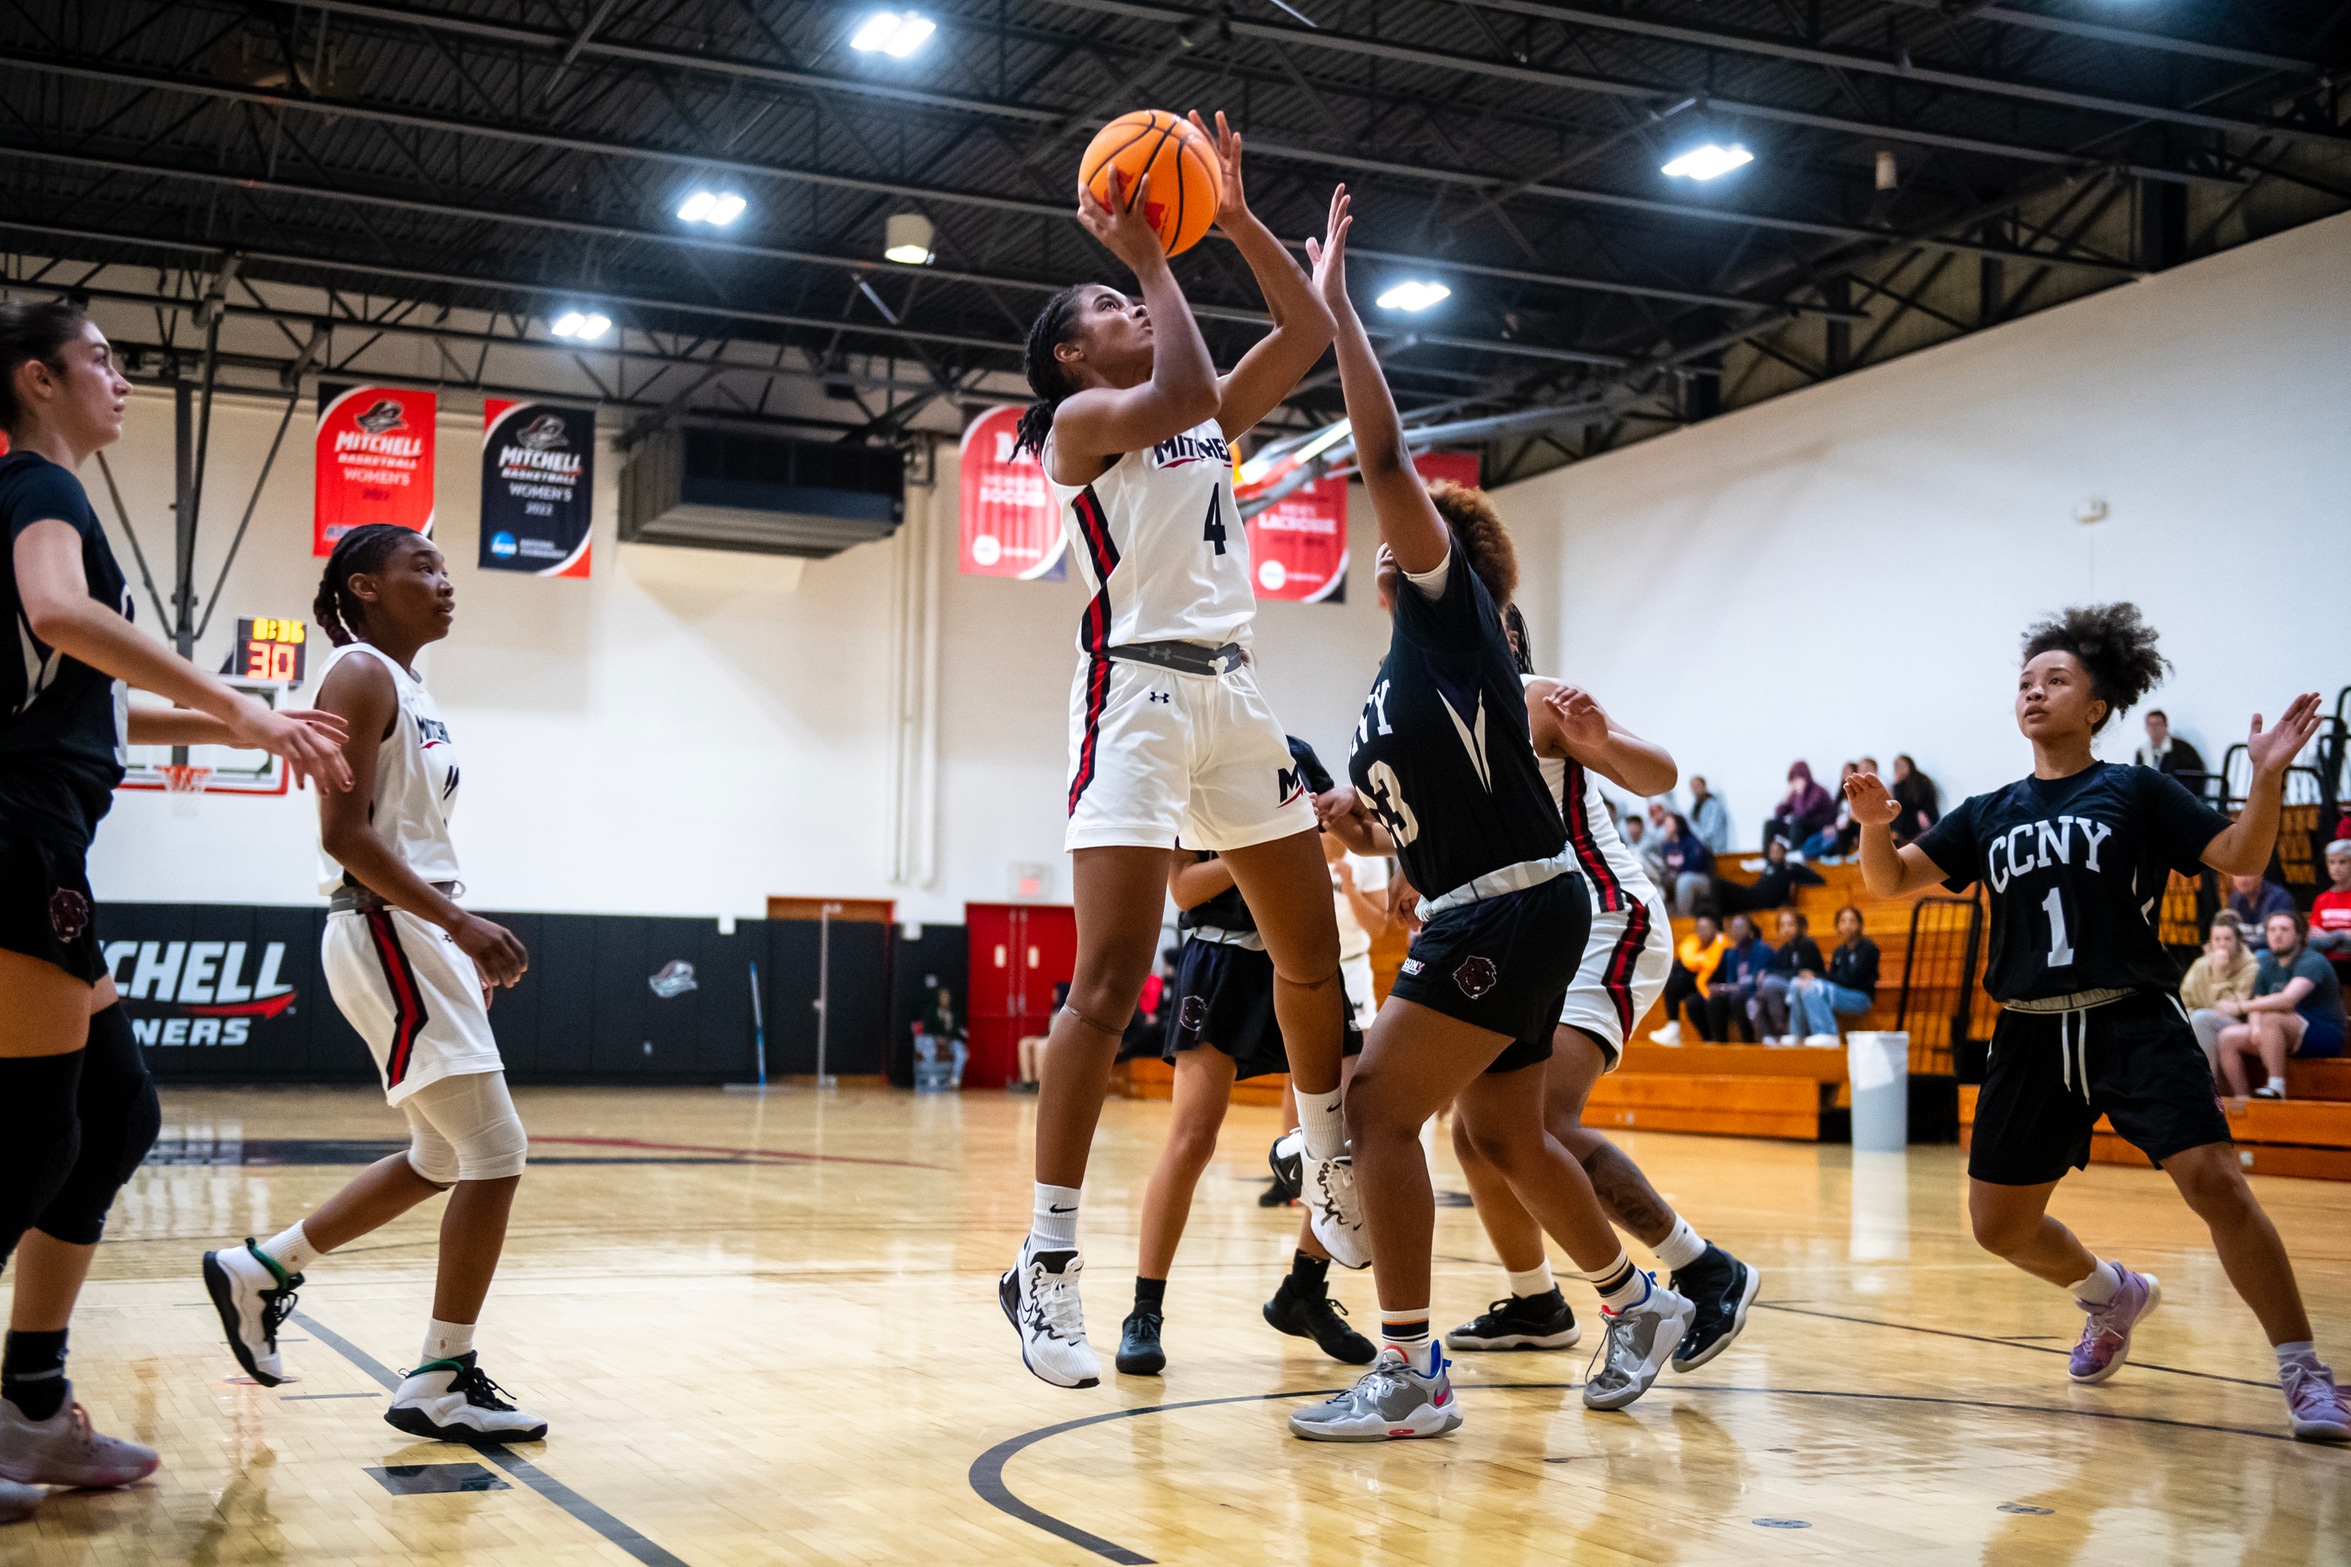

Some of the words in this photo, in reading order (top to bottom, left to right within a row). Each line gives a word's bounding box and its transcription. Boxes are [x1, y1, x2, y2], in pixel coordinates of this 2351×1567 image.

[334, 430, 422, 457] MITCHELL
[337, 453, 417, 471] BASKETBALL
[498, 445, 582, 473] MITCHELL
[344, 468, 411, 486] WOMEN'S
[501, 468, 577, 486] BASKETBALL
[508, 482, 573, 502] WOMEN'S
[1203, 482, 1227, 555] 4
[247, 641, 296, 681] 30
[1278, 764, 1301, 804] M
[1988, 815, 2112, 894] CCNY
[2041, 886, 2075, 968] 1
[99, 940, 293, 1005] CHELL
[132, 1017, 251, 1047] NERS
